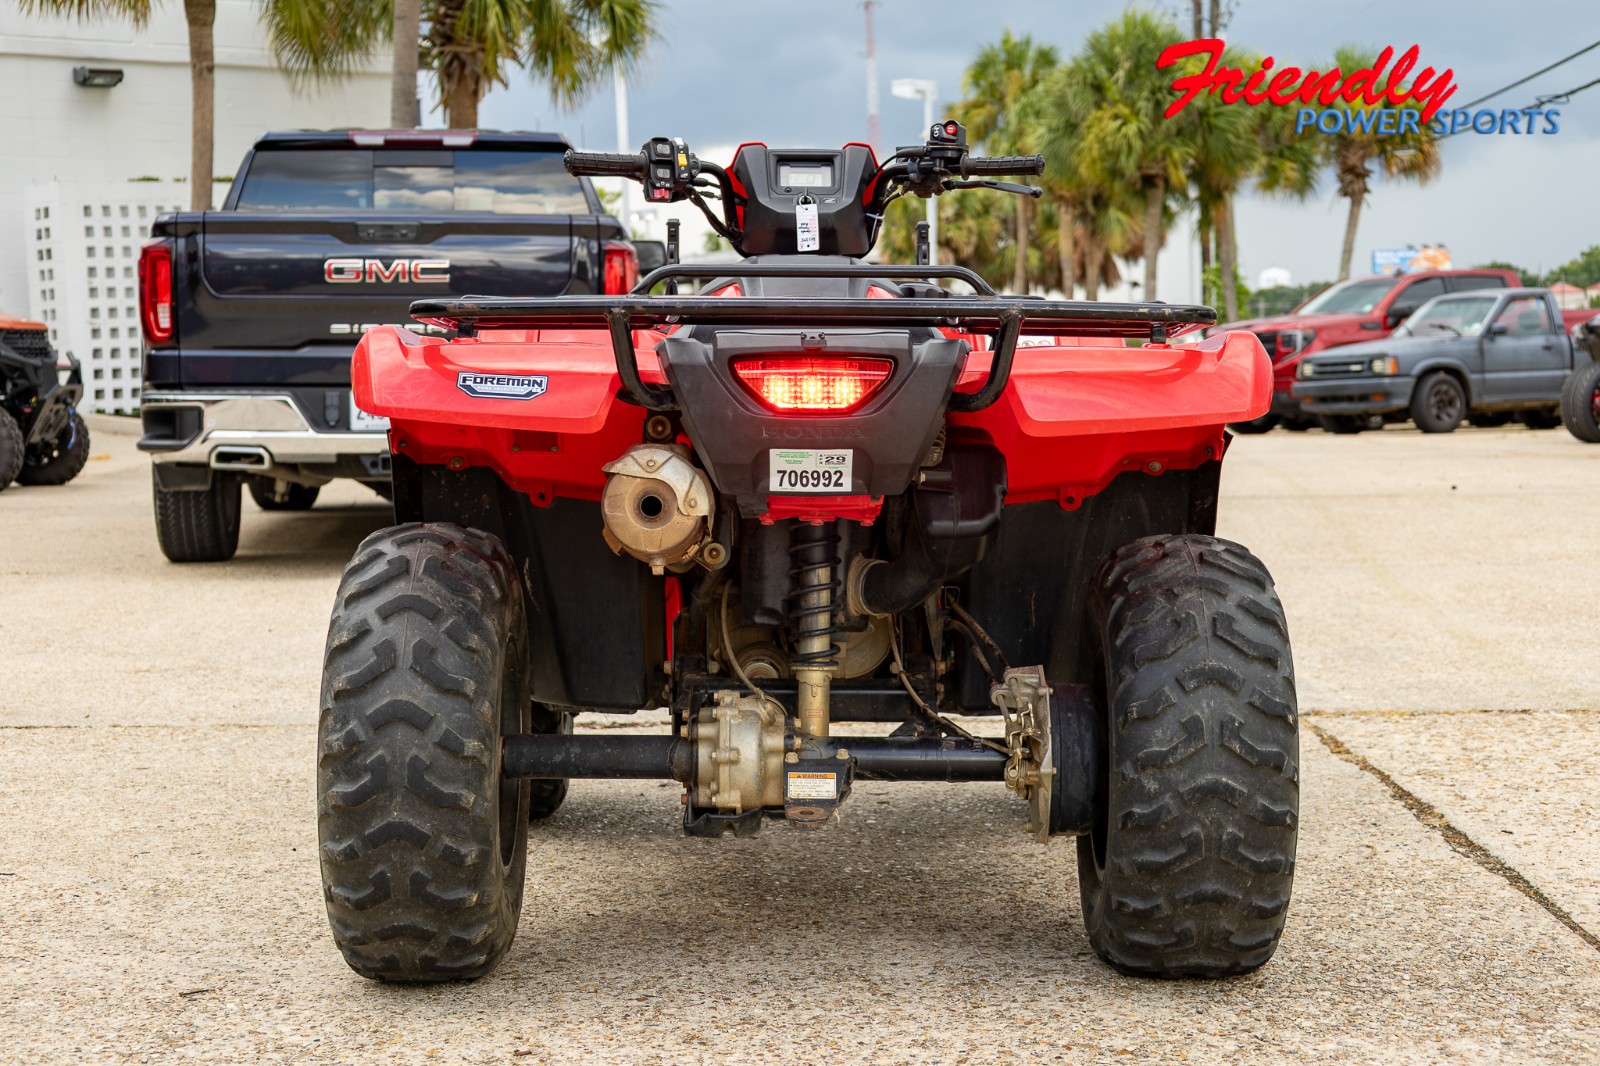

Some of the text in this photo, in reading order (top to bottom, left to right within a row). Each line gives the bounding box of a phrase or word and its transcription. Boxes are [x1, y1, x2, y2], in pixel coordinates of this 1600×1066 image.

[324, 258, 450, 283] GMC
[461, 376, 543, 387] FOREMAN
[760, 426, 868, 439] HONDA
[777, 470, 843, 487] 706992
